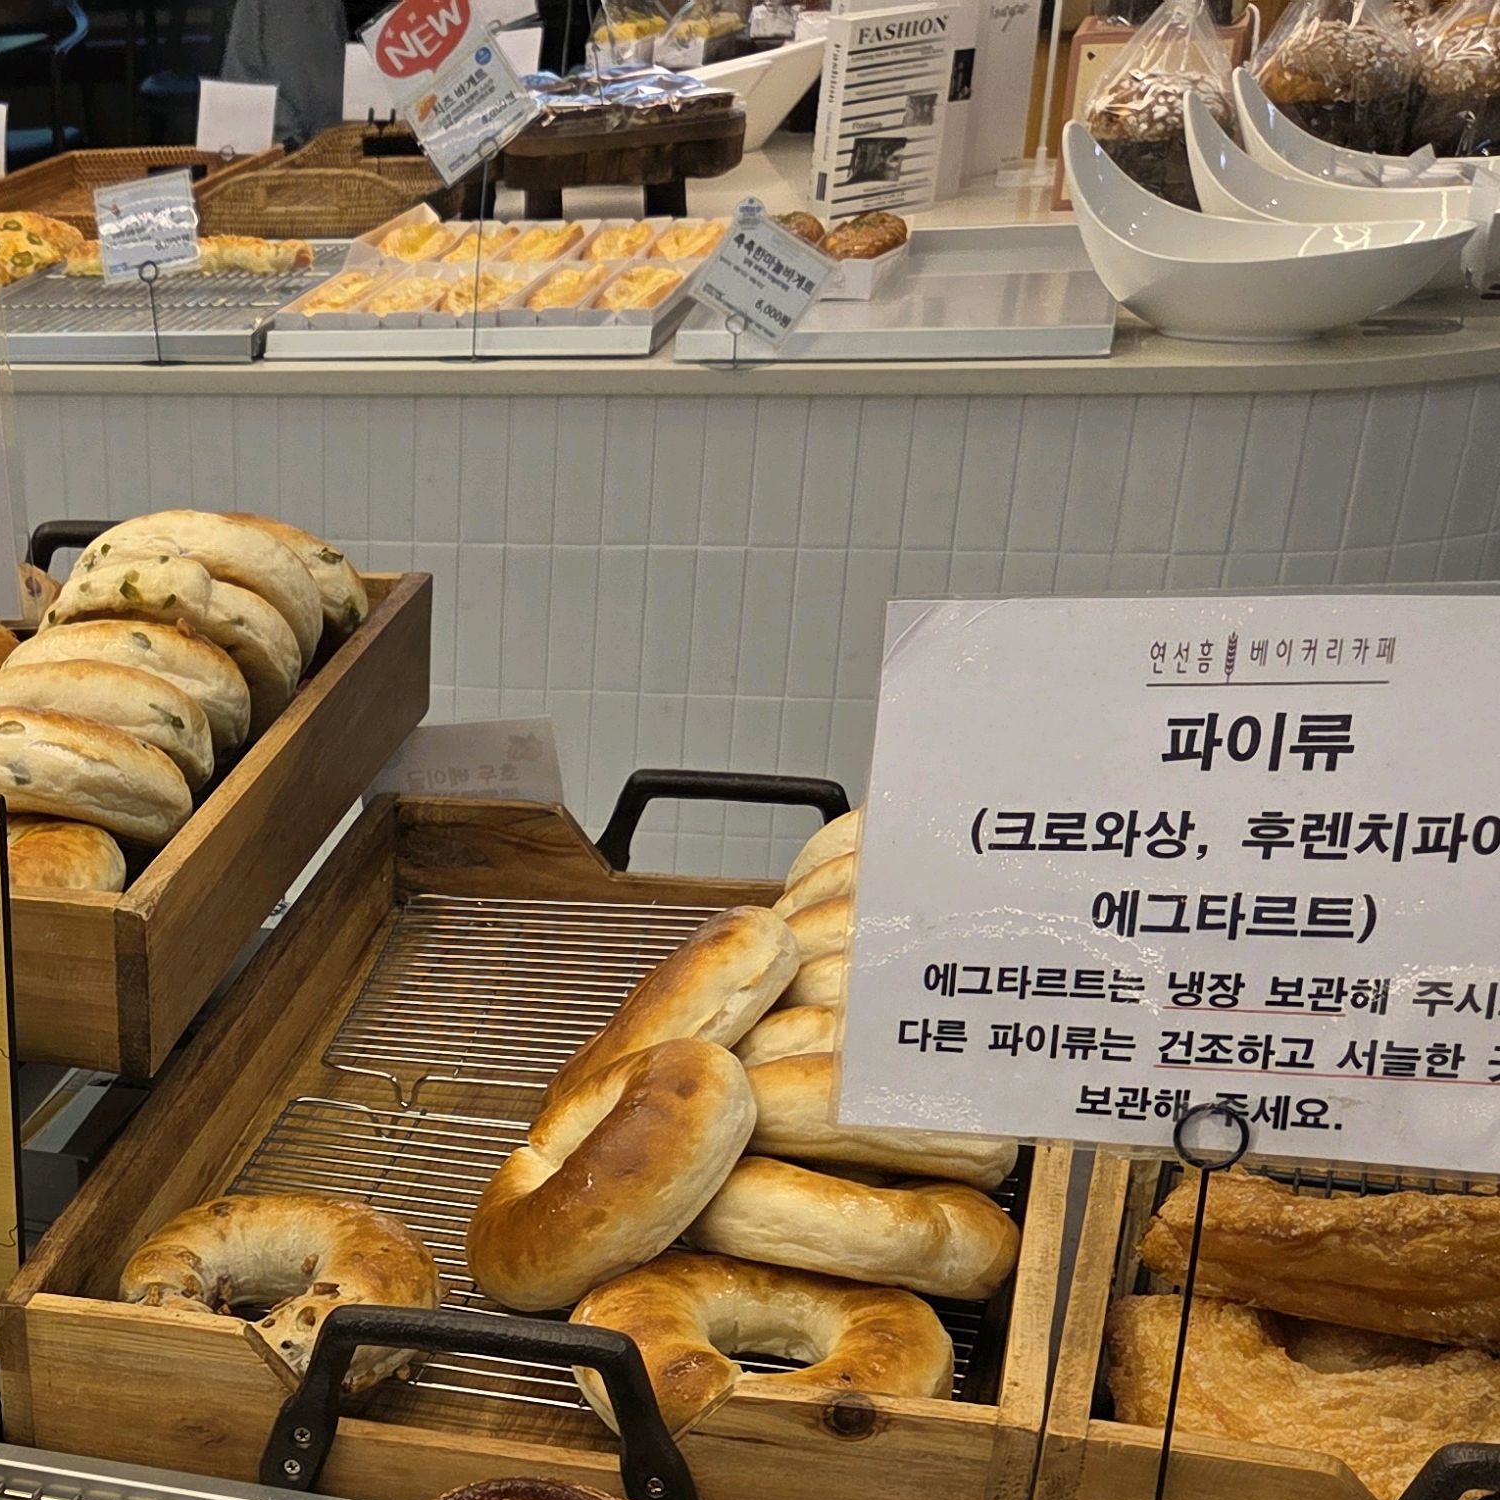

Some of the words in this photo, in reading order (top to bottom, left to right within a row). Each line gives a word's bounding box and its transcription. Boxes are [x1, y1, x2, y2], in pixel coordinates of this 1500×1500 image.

[384, 1, 462, 71] NEW
[857, 15, 949, 46] FASHION
[1149, 639, 1214, 675] 연선흠
[1249, 636, 1397, 667] 베이커리카페
[1161, 712, 1355, 772] 파이류
[971, 807, 1209, 861] (크로와상,
[1091, 889, 1378, 944] 에그타르트)
[923, 962, 1145, 1005] 에그타르트는
[1167, 971, 1245, 1009] 냉장
[1264, 975, 1391, 1016] 보관해
[1412, 981, 1500, 1020] 주시
[898, 1018, 969, 1055] 다른
[987, 1022, 1137, 1062] 파이류는
[1157, 1029, 1315, 1070] 건조하고
[1336, 1039, 1466, 1080] 서늘한
[1074, 1084, 1191, 1122] 보관해
[1214, 1090, 1344, 1132] 주세요.
